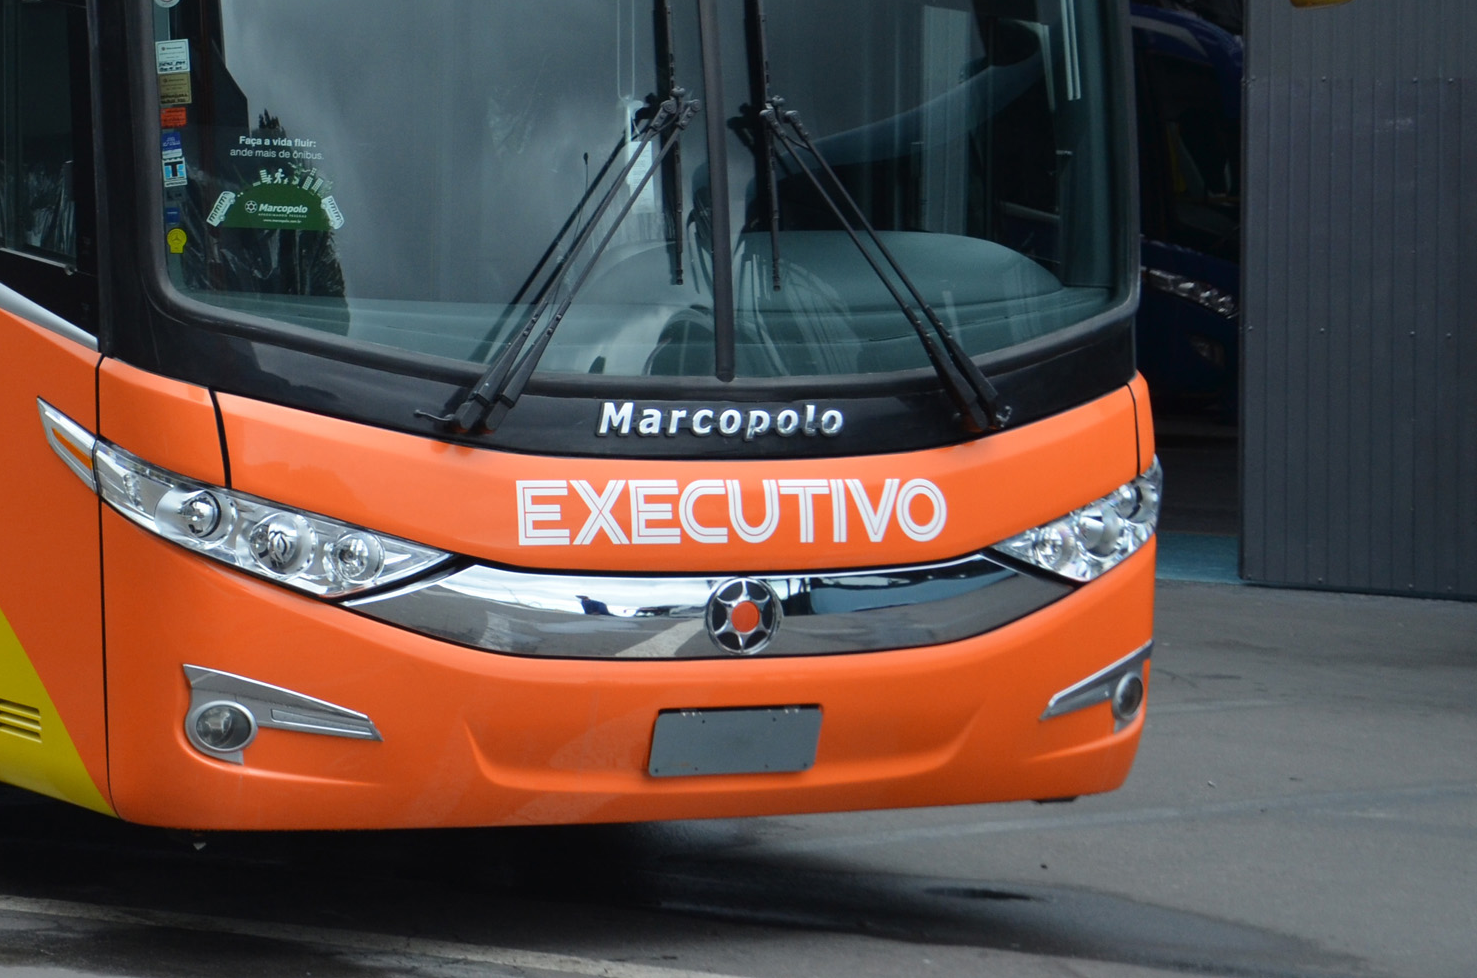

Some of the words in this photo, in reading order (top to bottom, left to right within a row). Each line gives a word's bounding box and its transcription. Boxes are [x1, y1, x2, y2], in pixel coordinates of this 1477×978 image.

[239, 136, 262, 147] Faça
[272, 137, 293, 146] vida
[230, 148, 253, 157] ande
[255, 149, 277, 158] mais
[278, 150, 291, 159] de
[258, 203, 308, 214] Marcopolo
[597, 401, 844, 441] Marcopolo
[515, 478, 948, 546] EXECUTIVO
